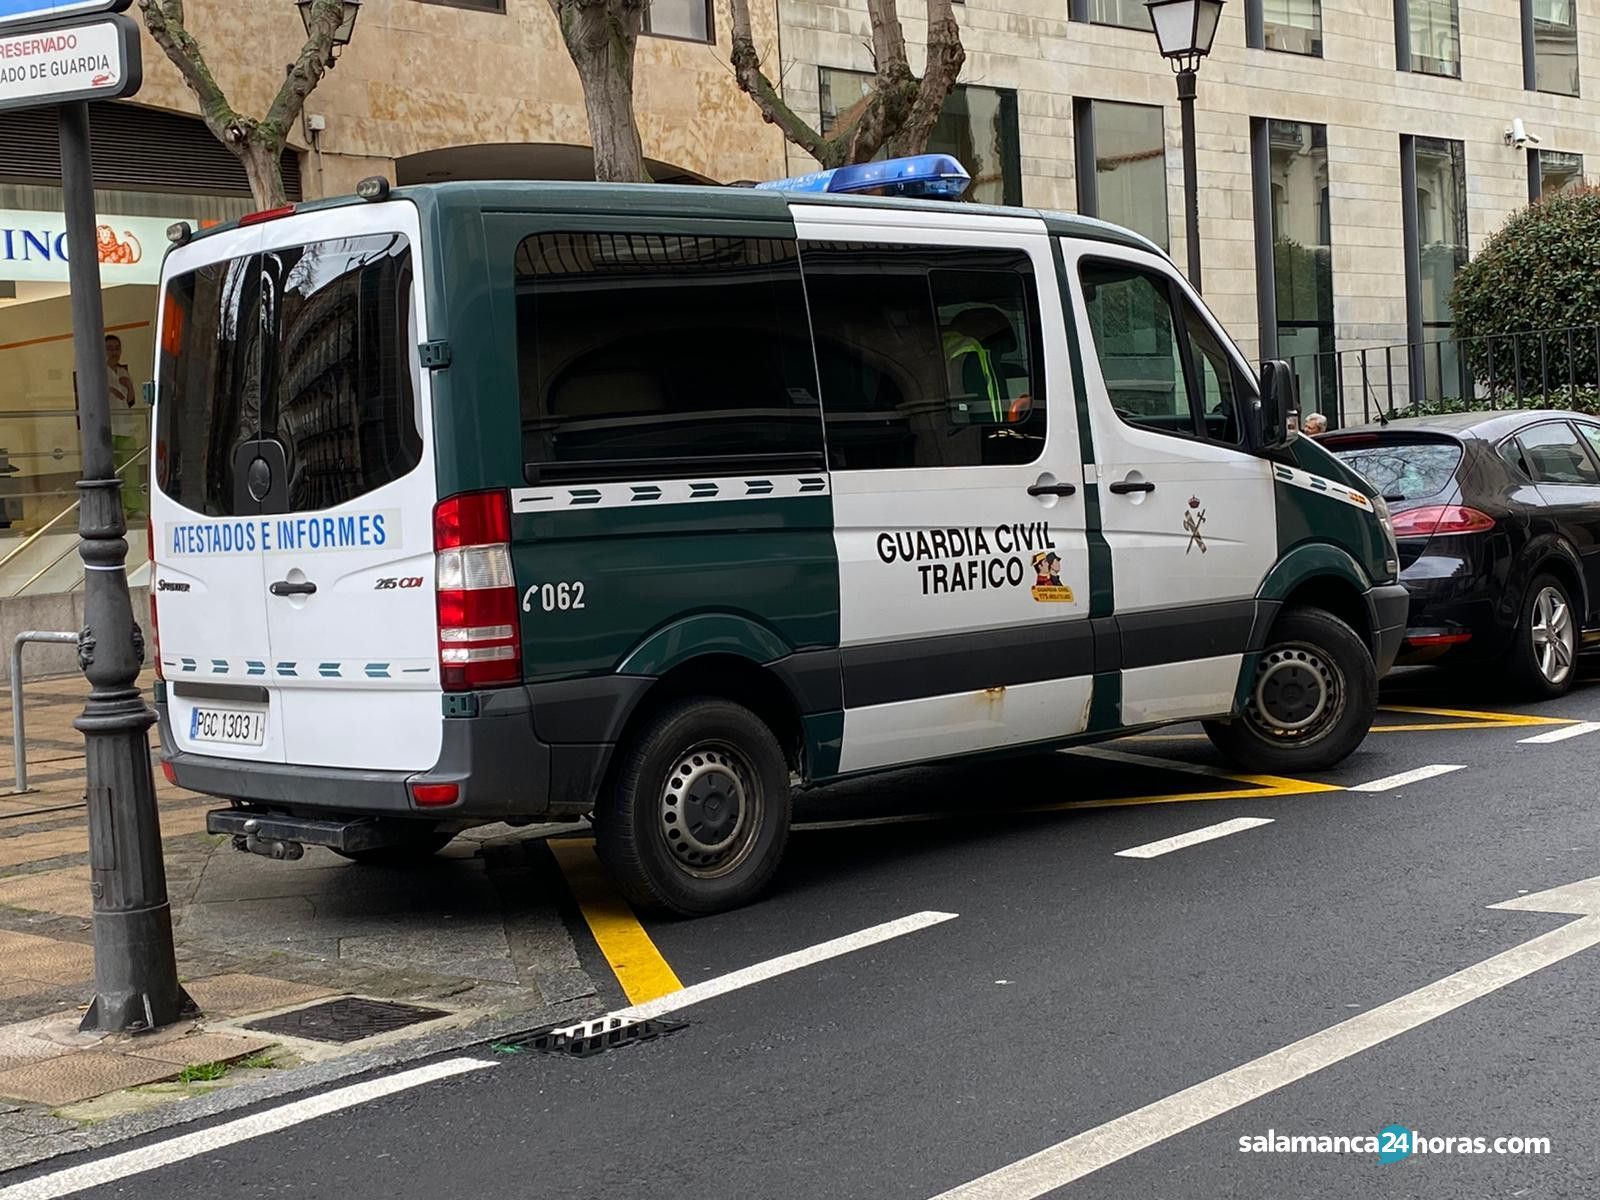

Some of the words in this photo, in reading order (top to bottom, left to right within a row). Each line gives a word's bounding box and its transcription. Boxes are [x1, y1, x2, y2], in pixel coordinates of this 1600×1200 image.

[30, 63, 46, 79] DE
[50, 54, 110, 77] GUARDIA
[173, 521, 256, 554] ATESTADOS
[261, 521, 271, 550] E
[277, 514, 386, 549] INFORMES
[877, 527, 991, 563] GUARDIA
[995, 521, 1056, 553] CIVIL
[398, 576, 424, 589] CDI
[918, 556, 1024, 594] TRAFICO
[541, 581, 585, 612] 062
[195, 711, 219, 737] PGC
[222, 713, 251, 740] 1303
